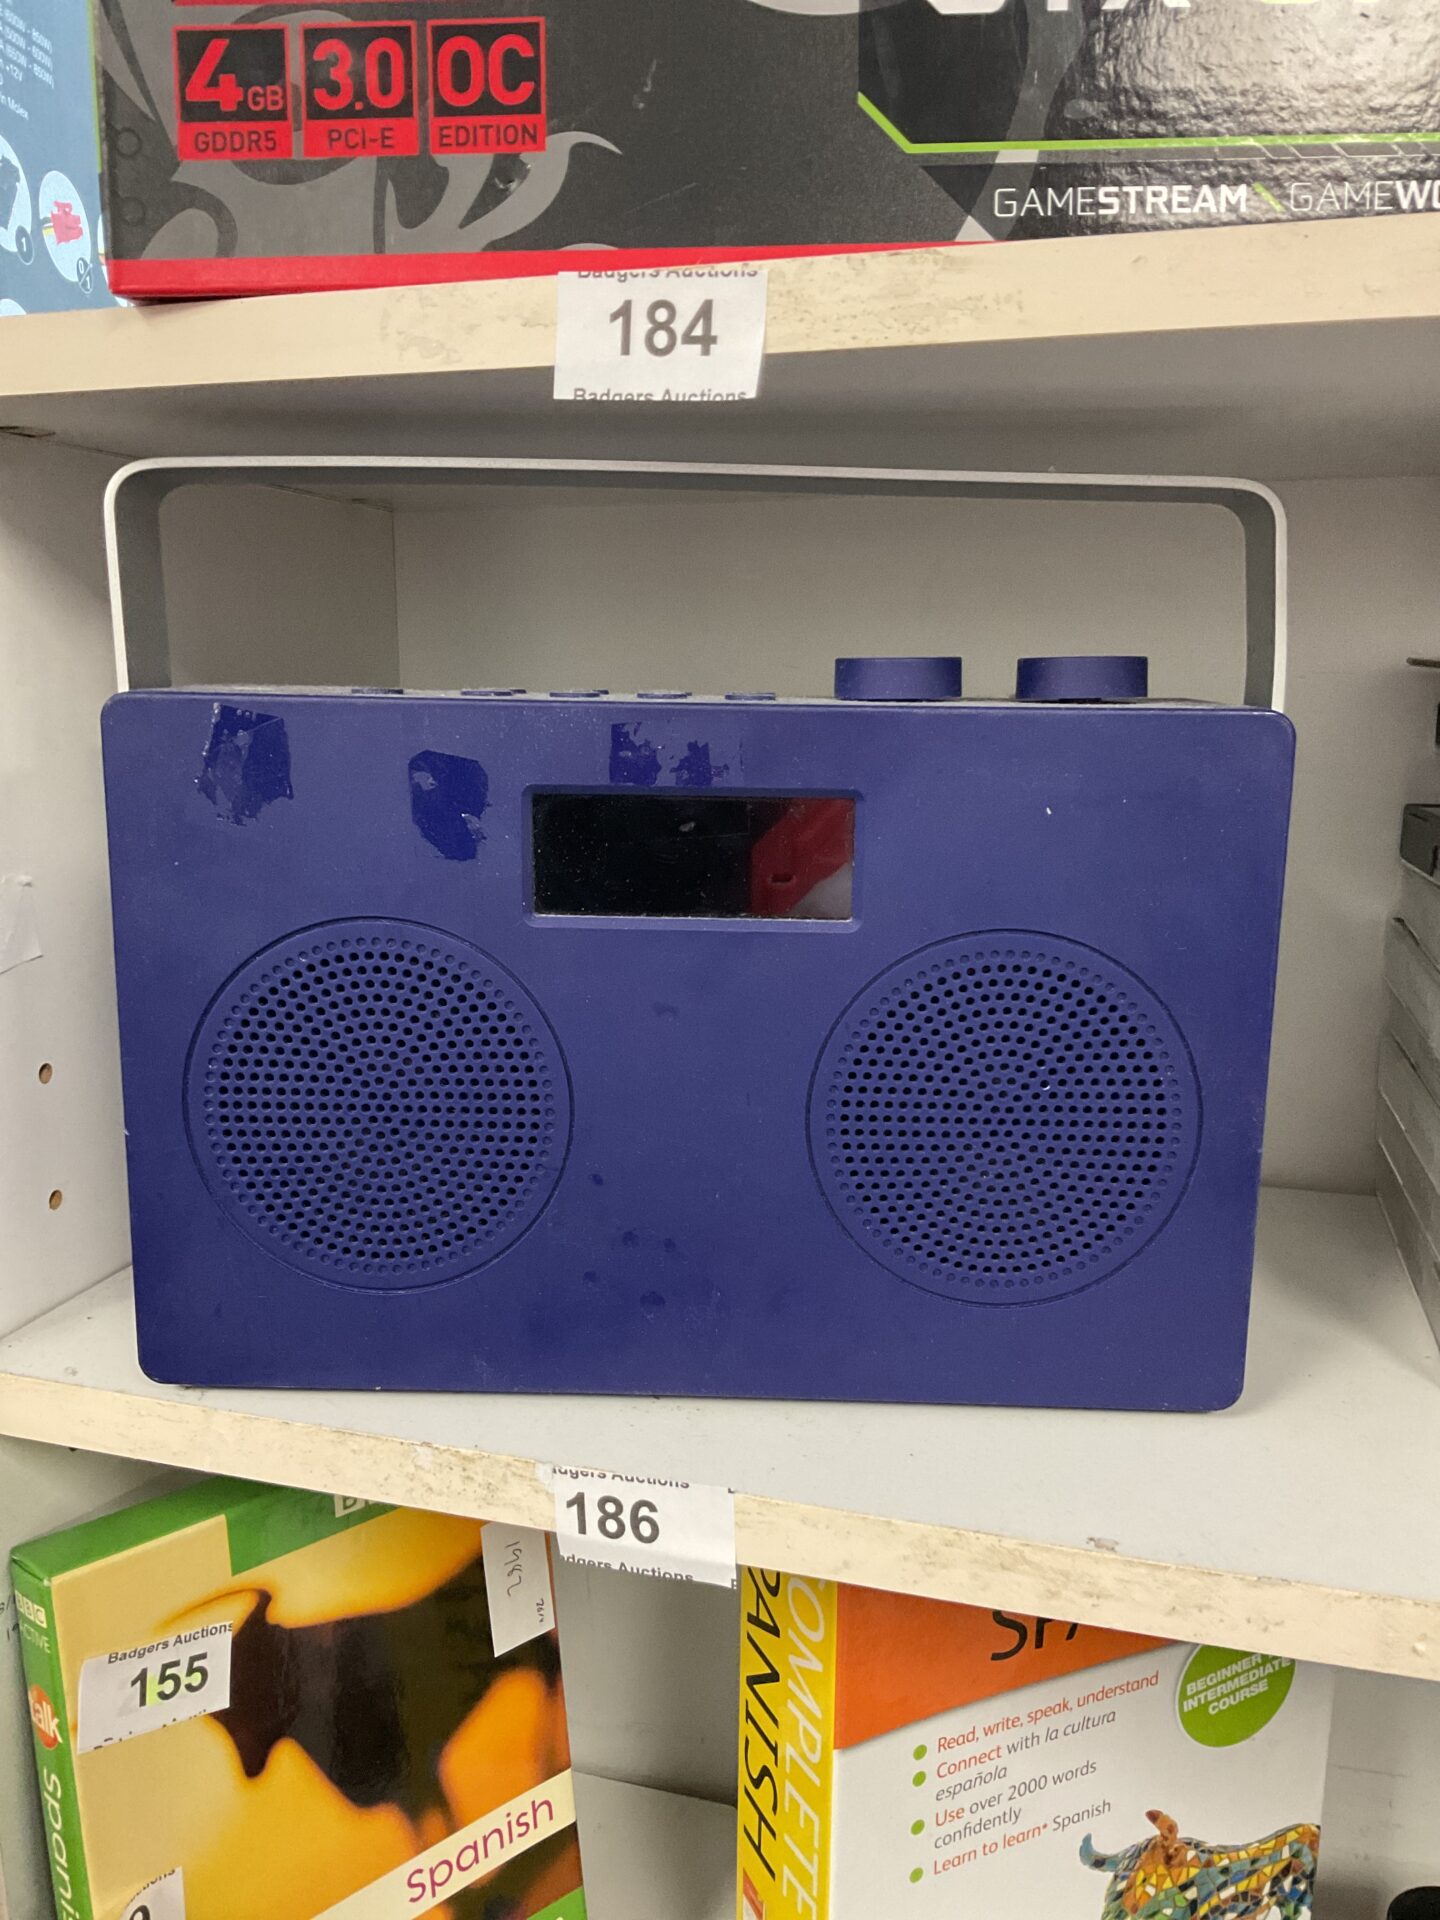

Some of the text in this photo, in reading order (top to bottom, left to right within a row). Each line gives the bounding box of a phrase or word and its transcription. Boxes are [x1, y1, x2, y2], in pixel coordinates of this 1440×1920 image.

[313, 37, 405, 111] 3.0
[437, 33, 535, 107] OC
[194, 130, 278, 154] GDDR5
[327, 127, 395, 150] PCI-E
[438, 123, 539, 148] EDITION
[993, 183, 1248, 218] GAMESTREAM
[609, 298, 718, 358] 184
[566, 1491, 660, 1544] 186
[107, 1640, 170, 1665] Badgers
[130, 1651, 209, 1708] 155
[1185, 1652, 1262, 1697] BEGINNER
[937, 1670, 1159, 1754] Read, write, speak, understand
[1182, 1656, 1292, 1713] INTERMEDIATE
[1207, 1678, 1270, 1716] COURSE
[782, 1576, 825, 1920] OMPLETE
[936, 1710, 1116, 1779] Connect with la cultura
[935, 1765, 1008, 1802] española
[935, 1760, 1097, 1827] Use over 2000 words
[934, 1806, 1022, 1849] confidently
[934, 1848, 977, 1876] Learn
[982, 1840, 998, 1856] to
[1052, 1799, 1112, 1833] Spanish
